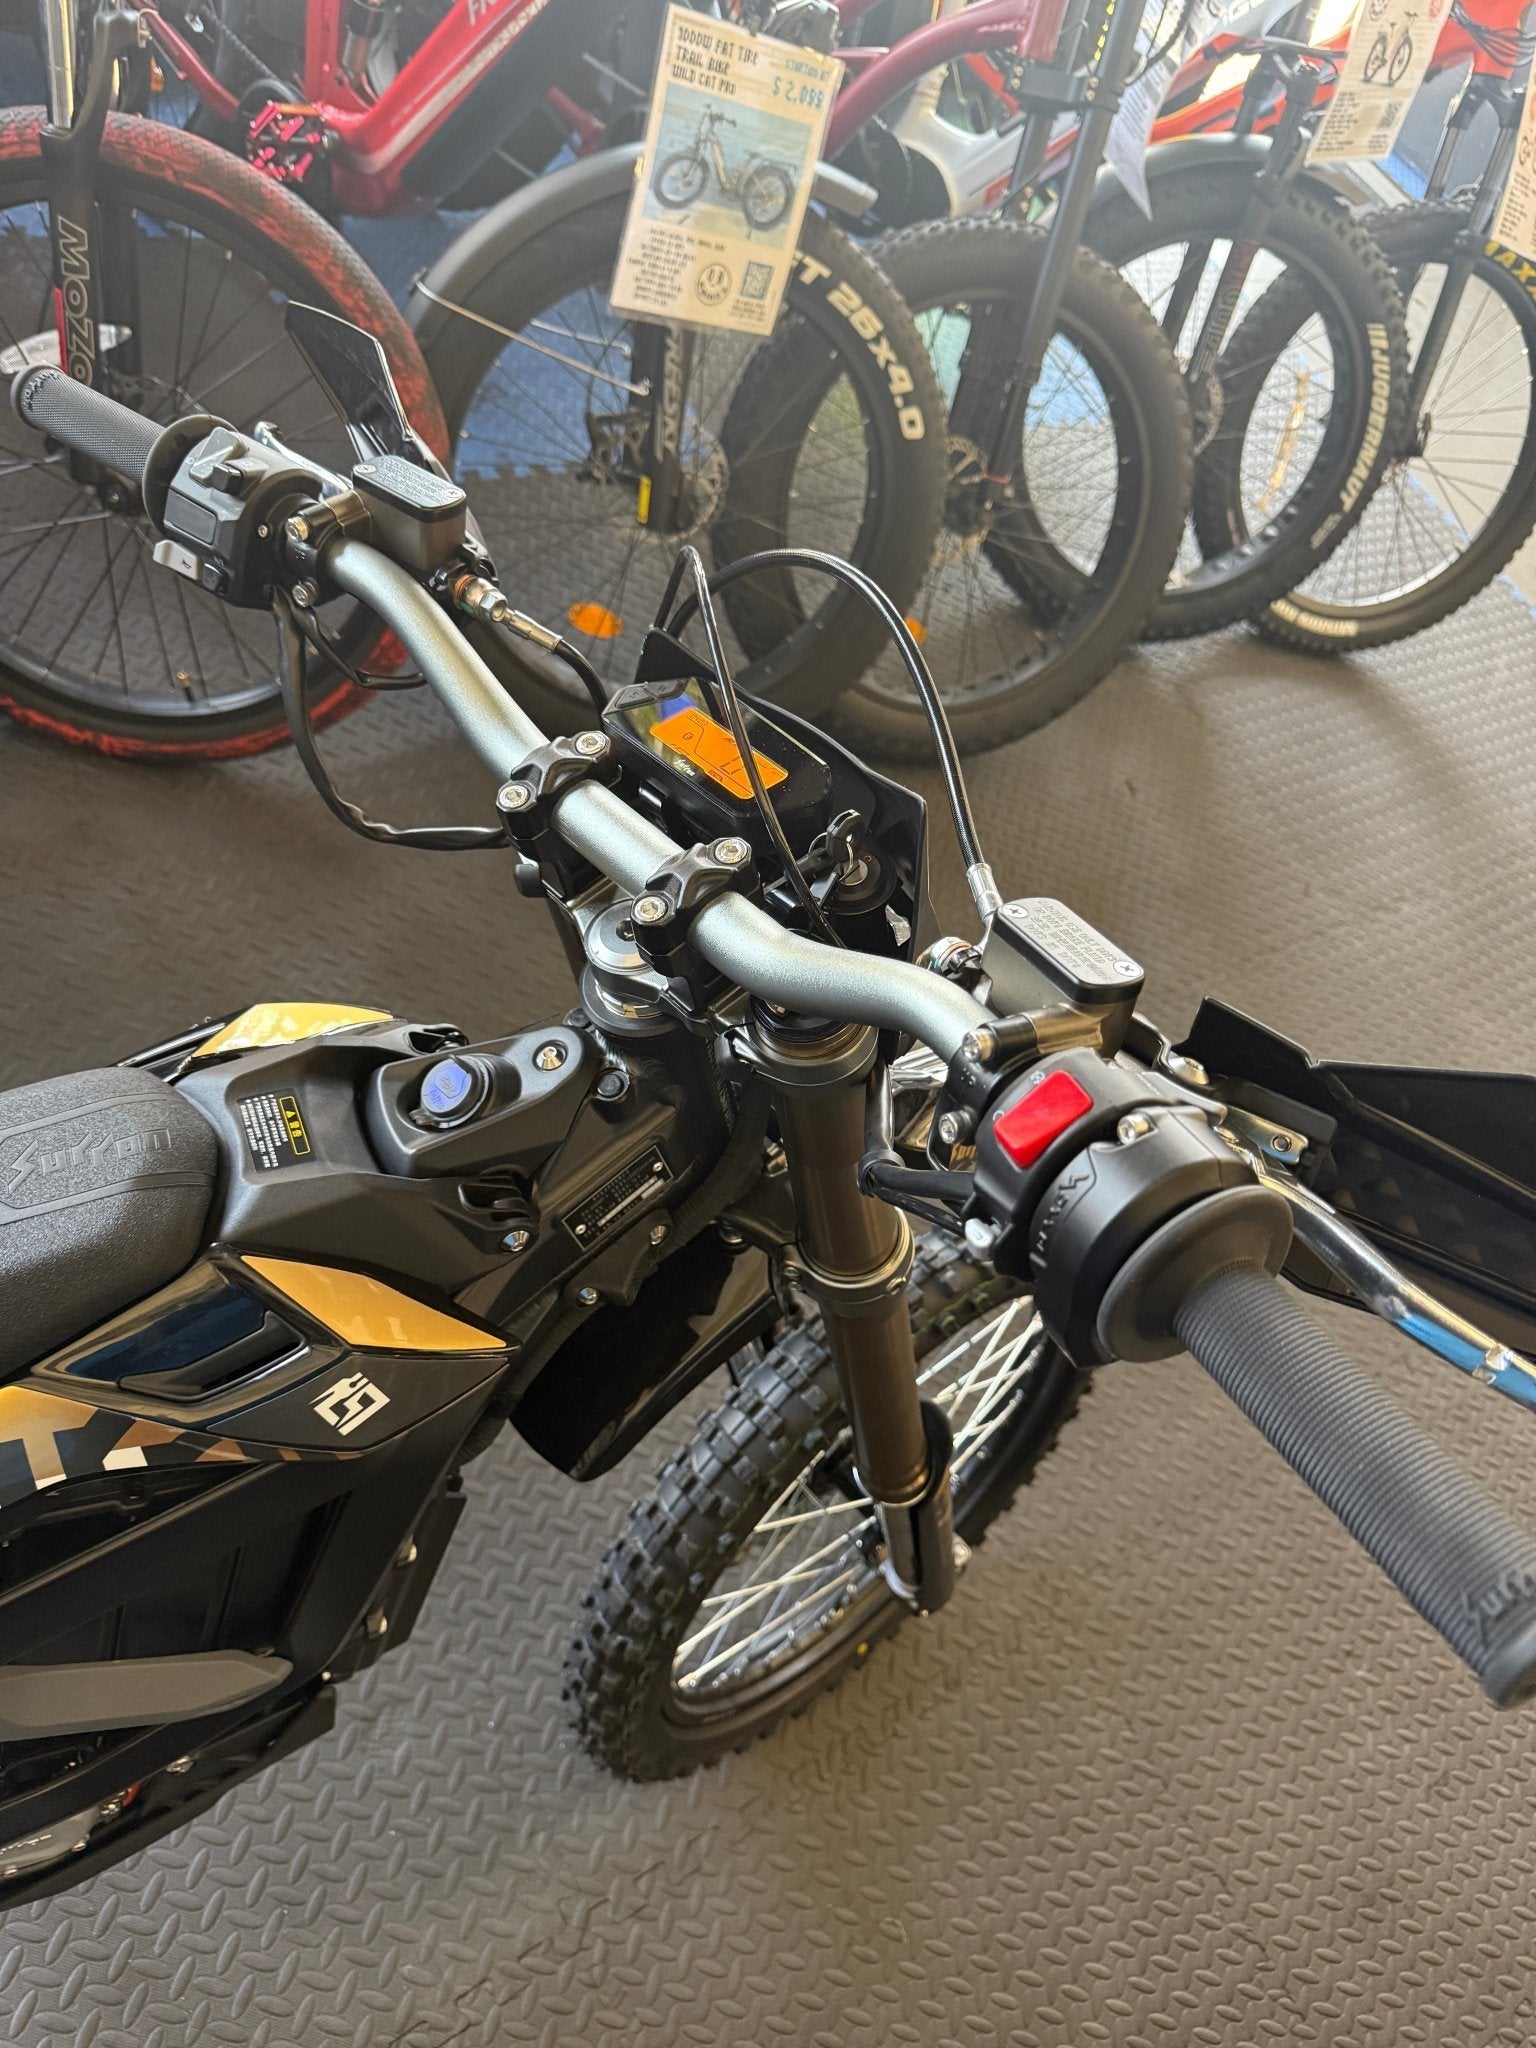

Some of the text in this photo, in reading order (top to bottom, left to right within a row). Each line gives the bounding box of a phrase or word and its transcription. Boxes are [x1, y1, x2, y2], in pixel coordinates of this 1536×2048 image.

[675, 46, 731, 75] TRAIL BIKE
[715, 39, 734, 57] FAT
[672, 64, 737, 96] WILD CAT PRO
[57, 215, 96, 387] MOZO
[1339, 350, 1392, 513] JUGGERNAUT
